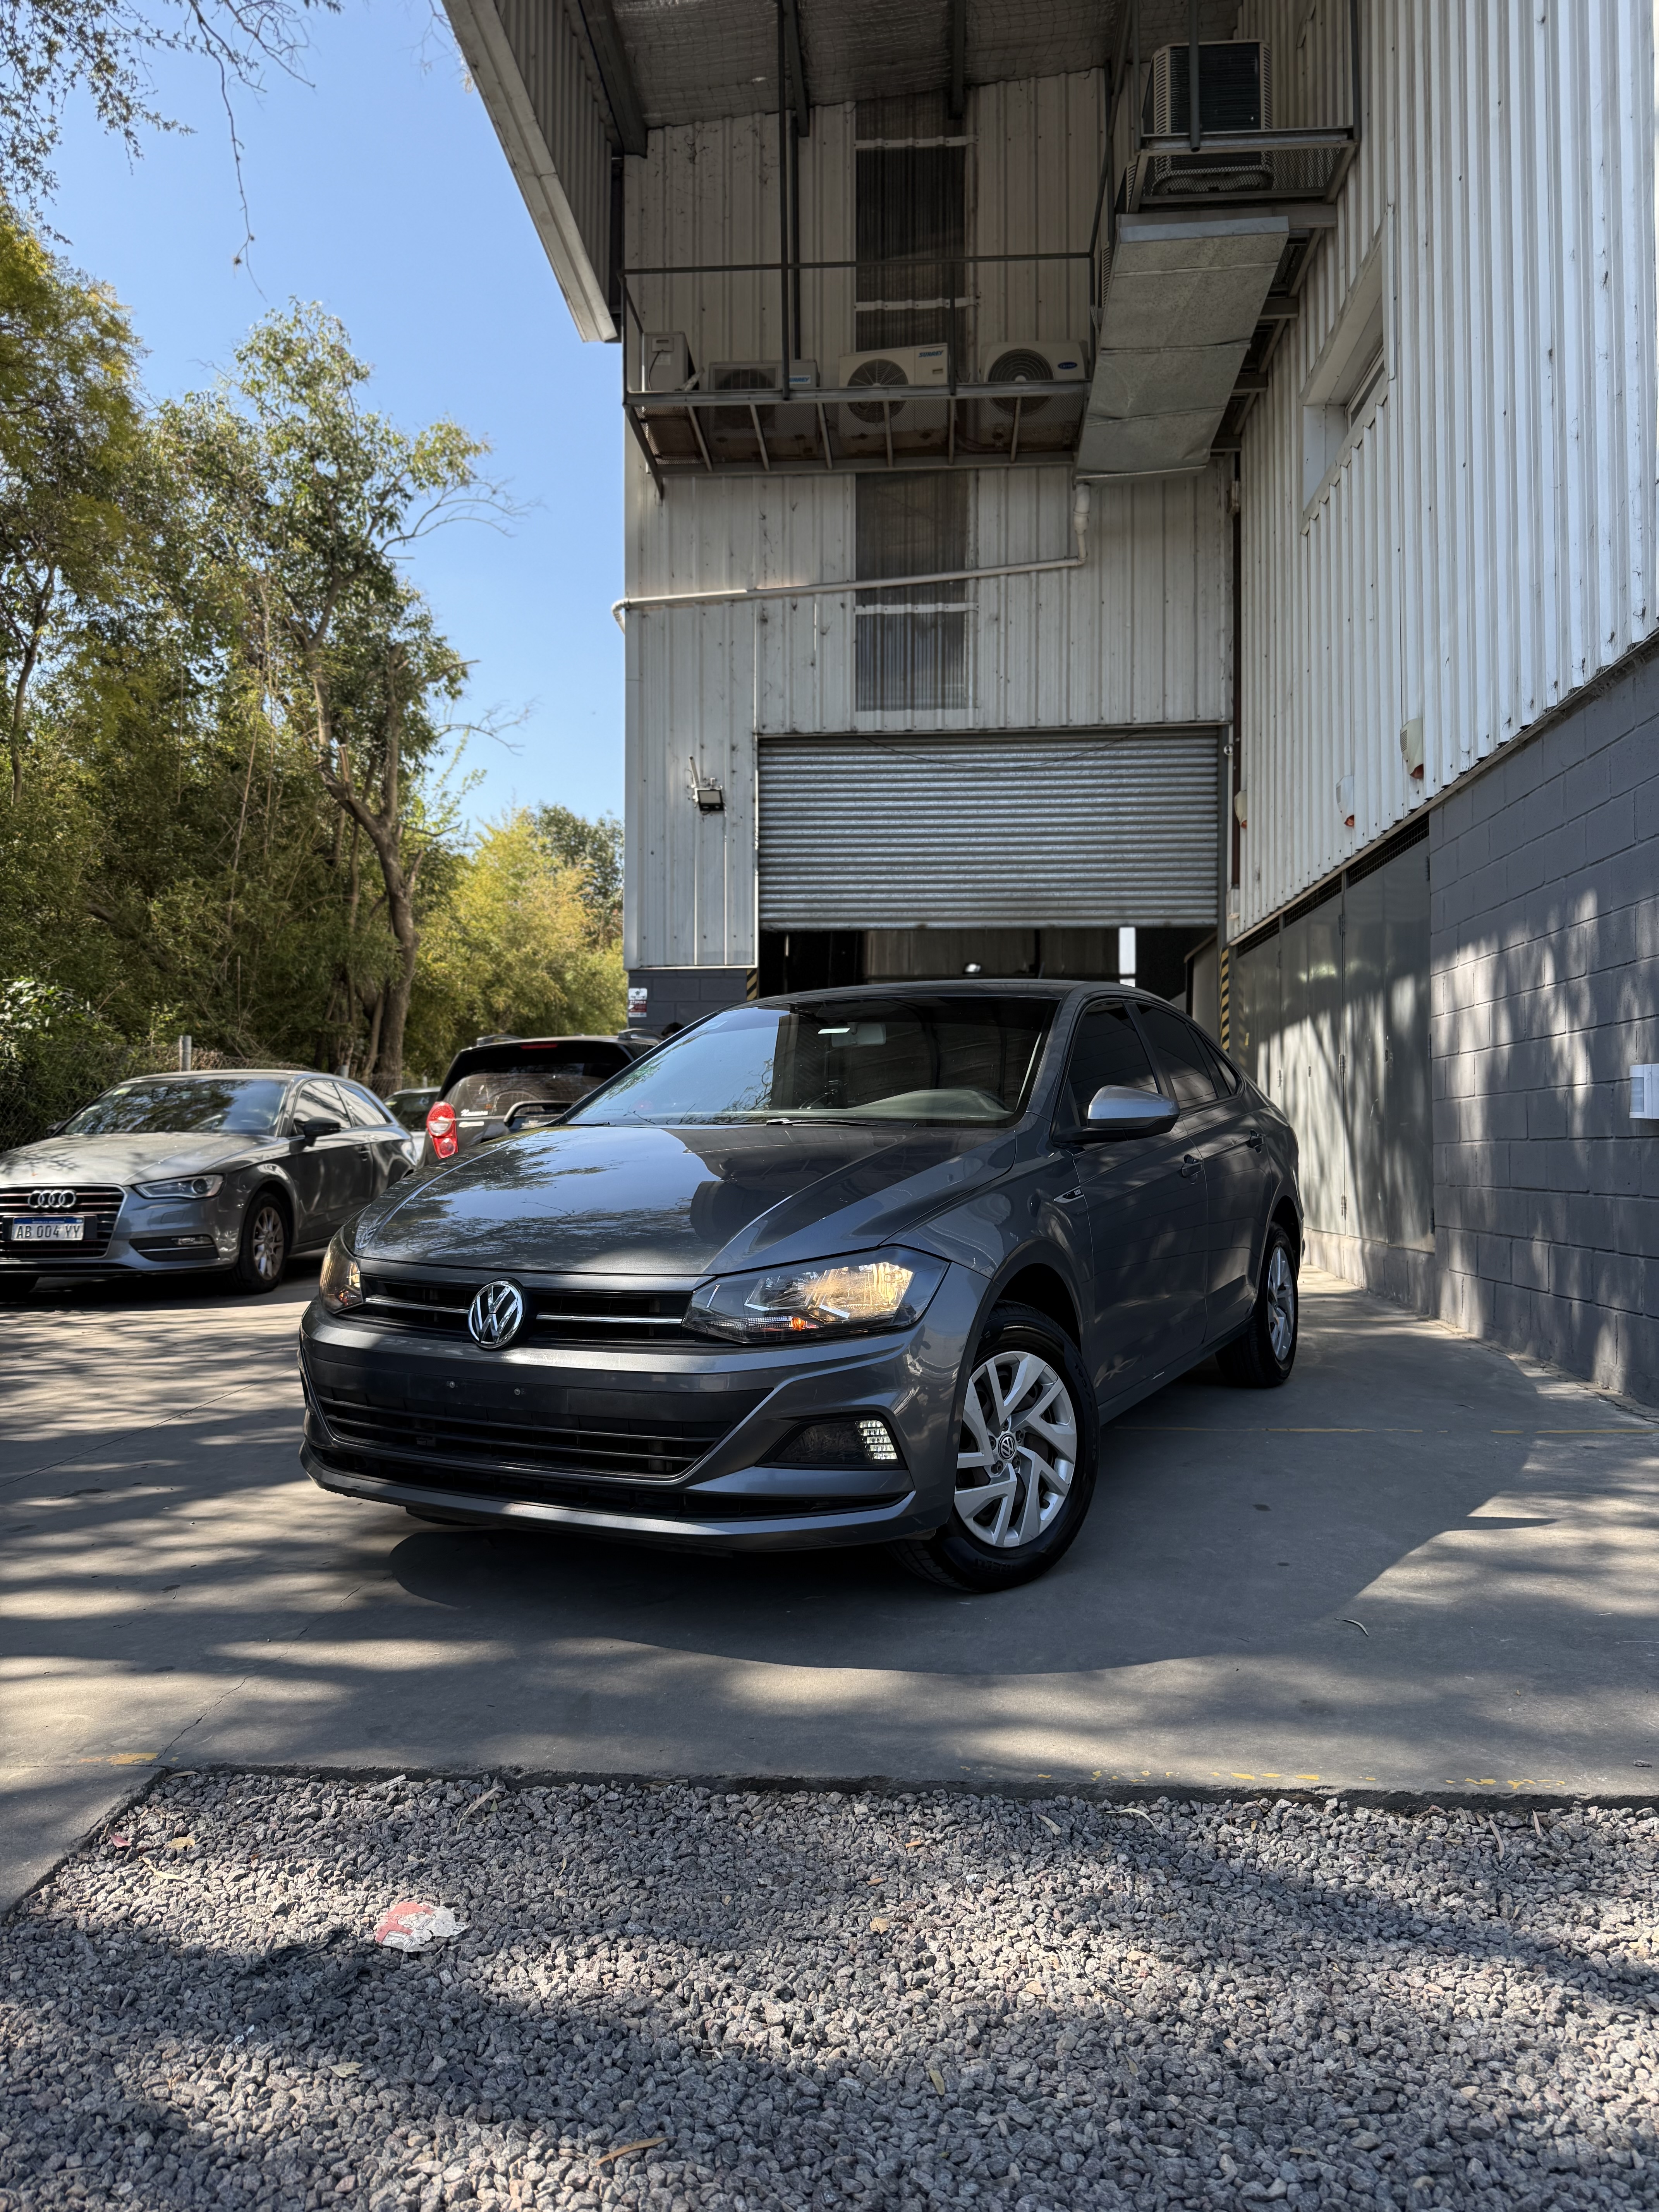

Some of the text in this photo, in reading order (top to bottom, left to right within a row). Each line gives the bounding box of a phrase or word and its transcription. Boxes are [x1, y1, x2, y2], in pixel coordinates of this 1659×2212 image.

[16, 1225, 81, 1238] AB 004 YY
